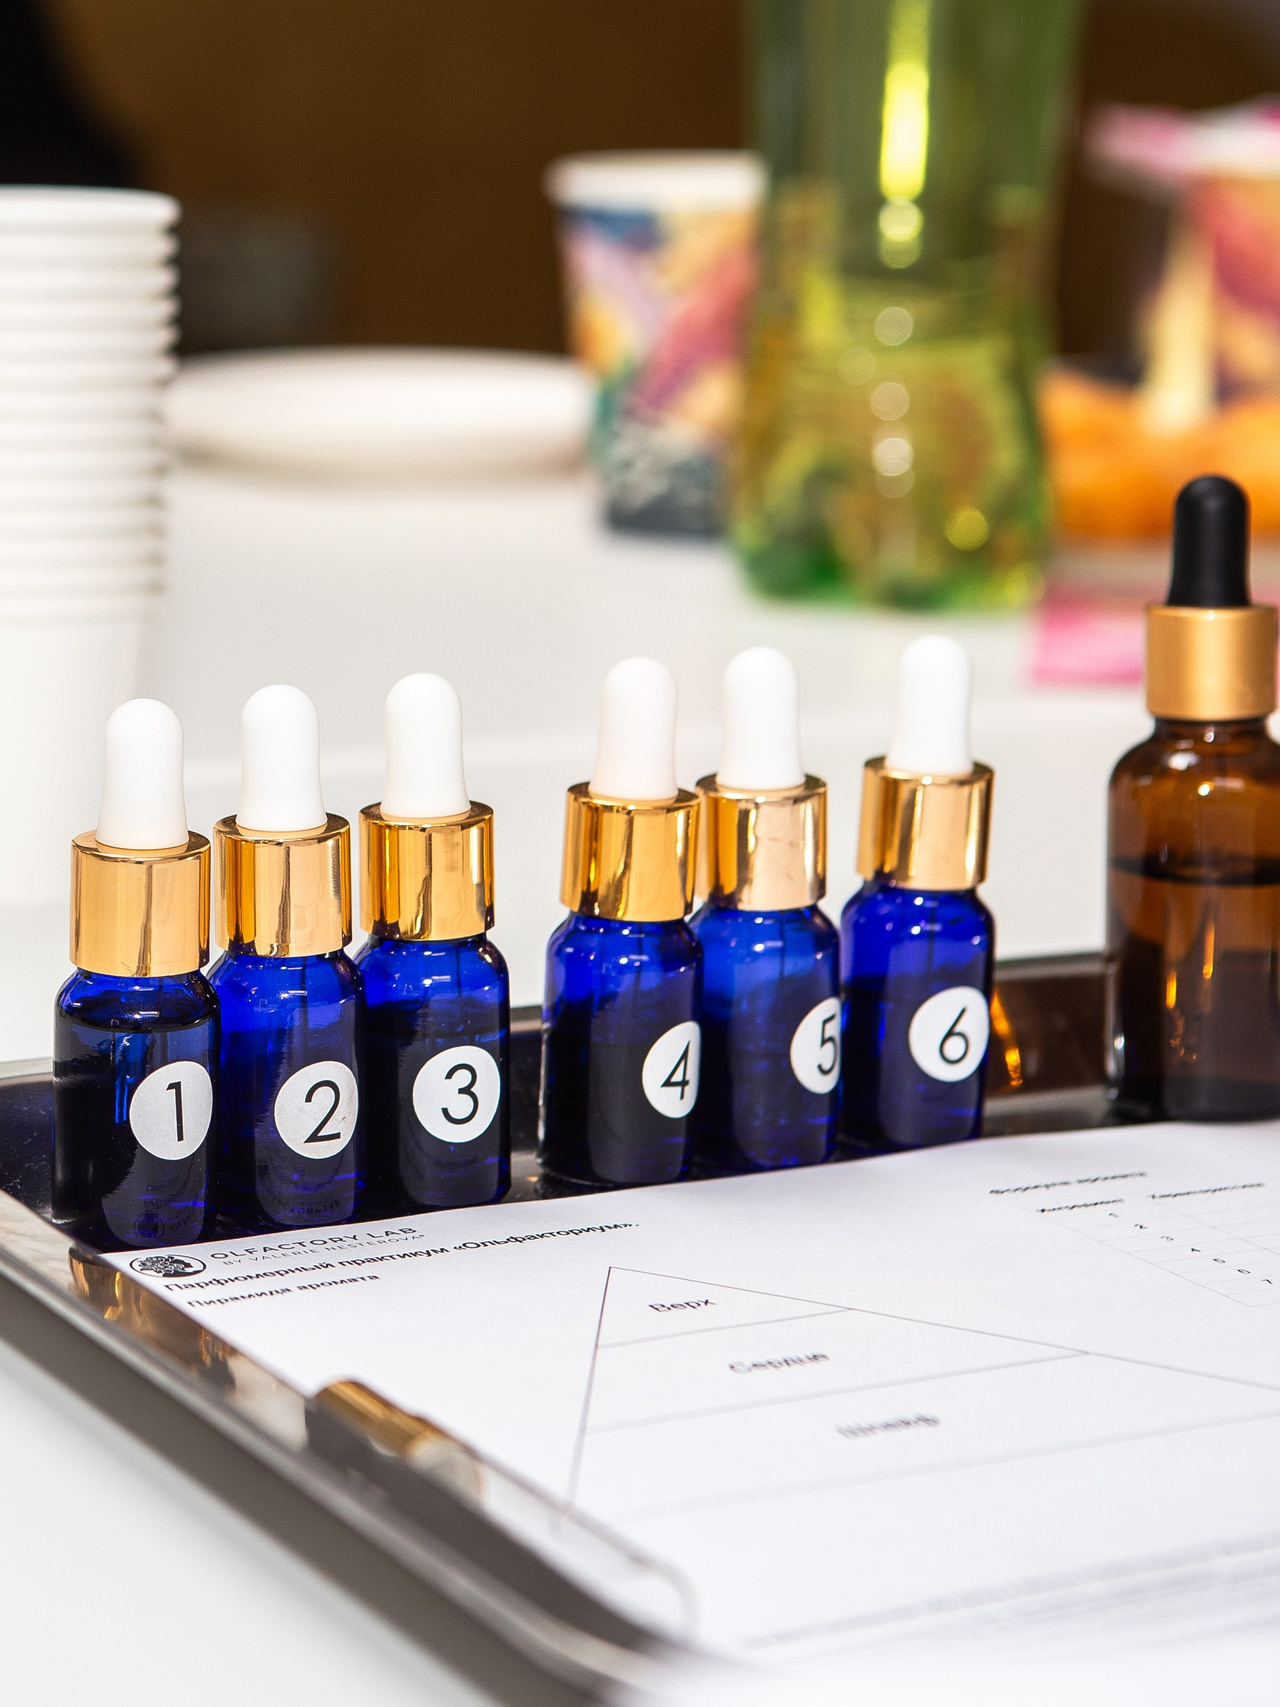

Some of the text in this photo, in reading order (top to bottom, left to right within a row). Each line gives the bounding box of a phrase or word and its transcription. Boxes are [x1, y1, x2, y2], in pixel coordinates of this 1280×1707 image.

[816, 1014, 836, 1076] 5
[939, 1006, 969, 1065] 6
[440, 1062, 479, 1125] 3
[660, 1040, 691, 1100] 4
[166, 1081, 184, 1142] 1
[303, 1079, 341, 1144] 2
[163, 1261, 337, 1293] Парфюмерный
[337, 1246, 450, 1269] практикум
[210, 1226, 418, 1260] OLFACTORY LAB
[187, 1273, 381, 1309] Пирамида аромата
[647, 1297, 718, 1315] Верх
